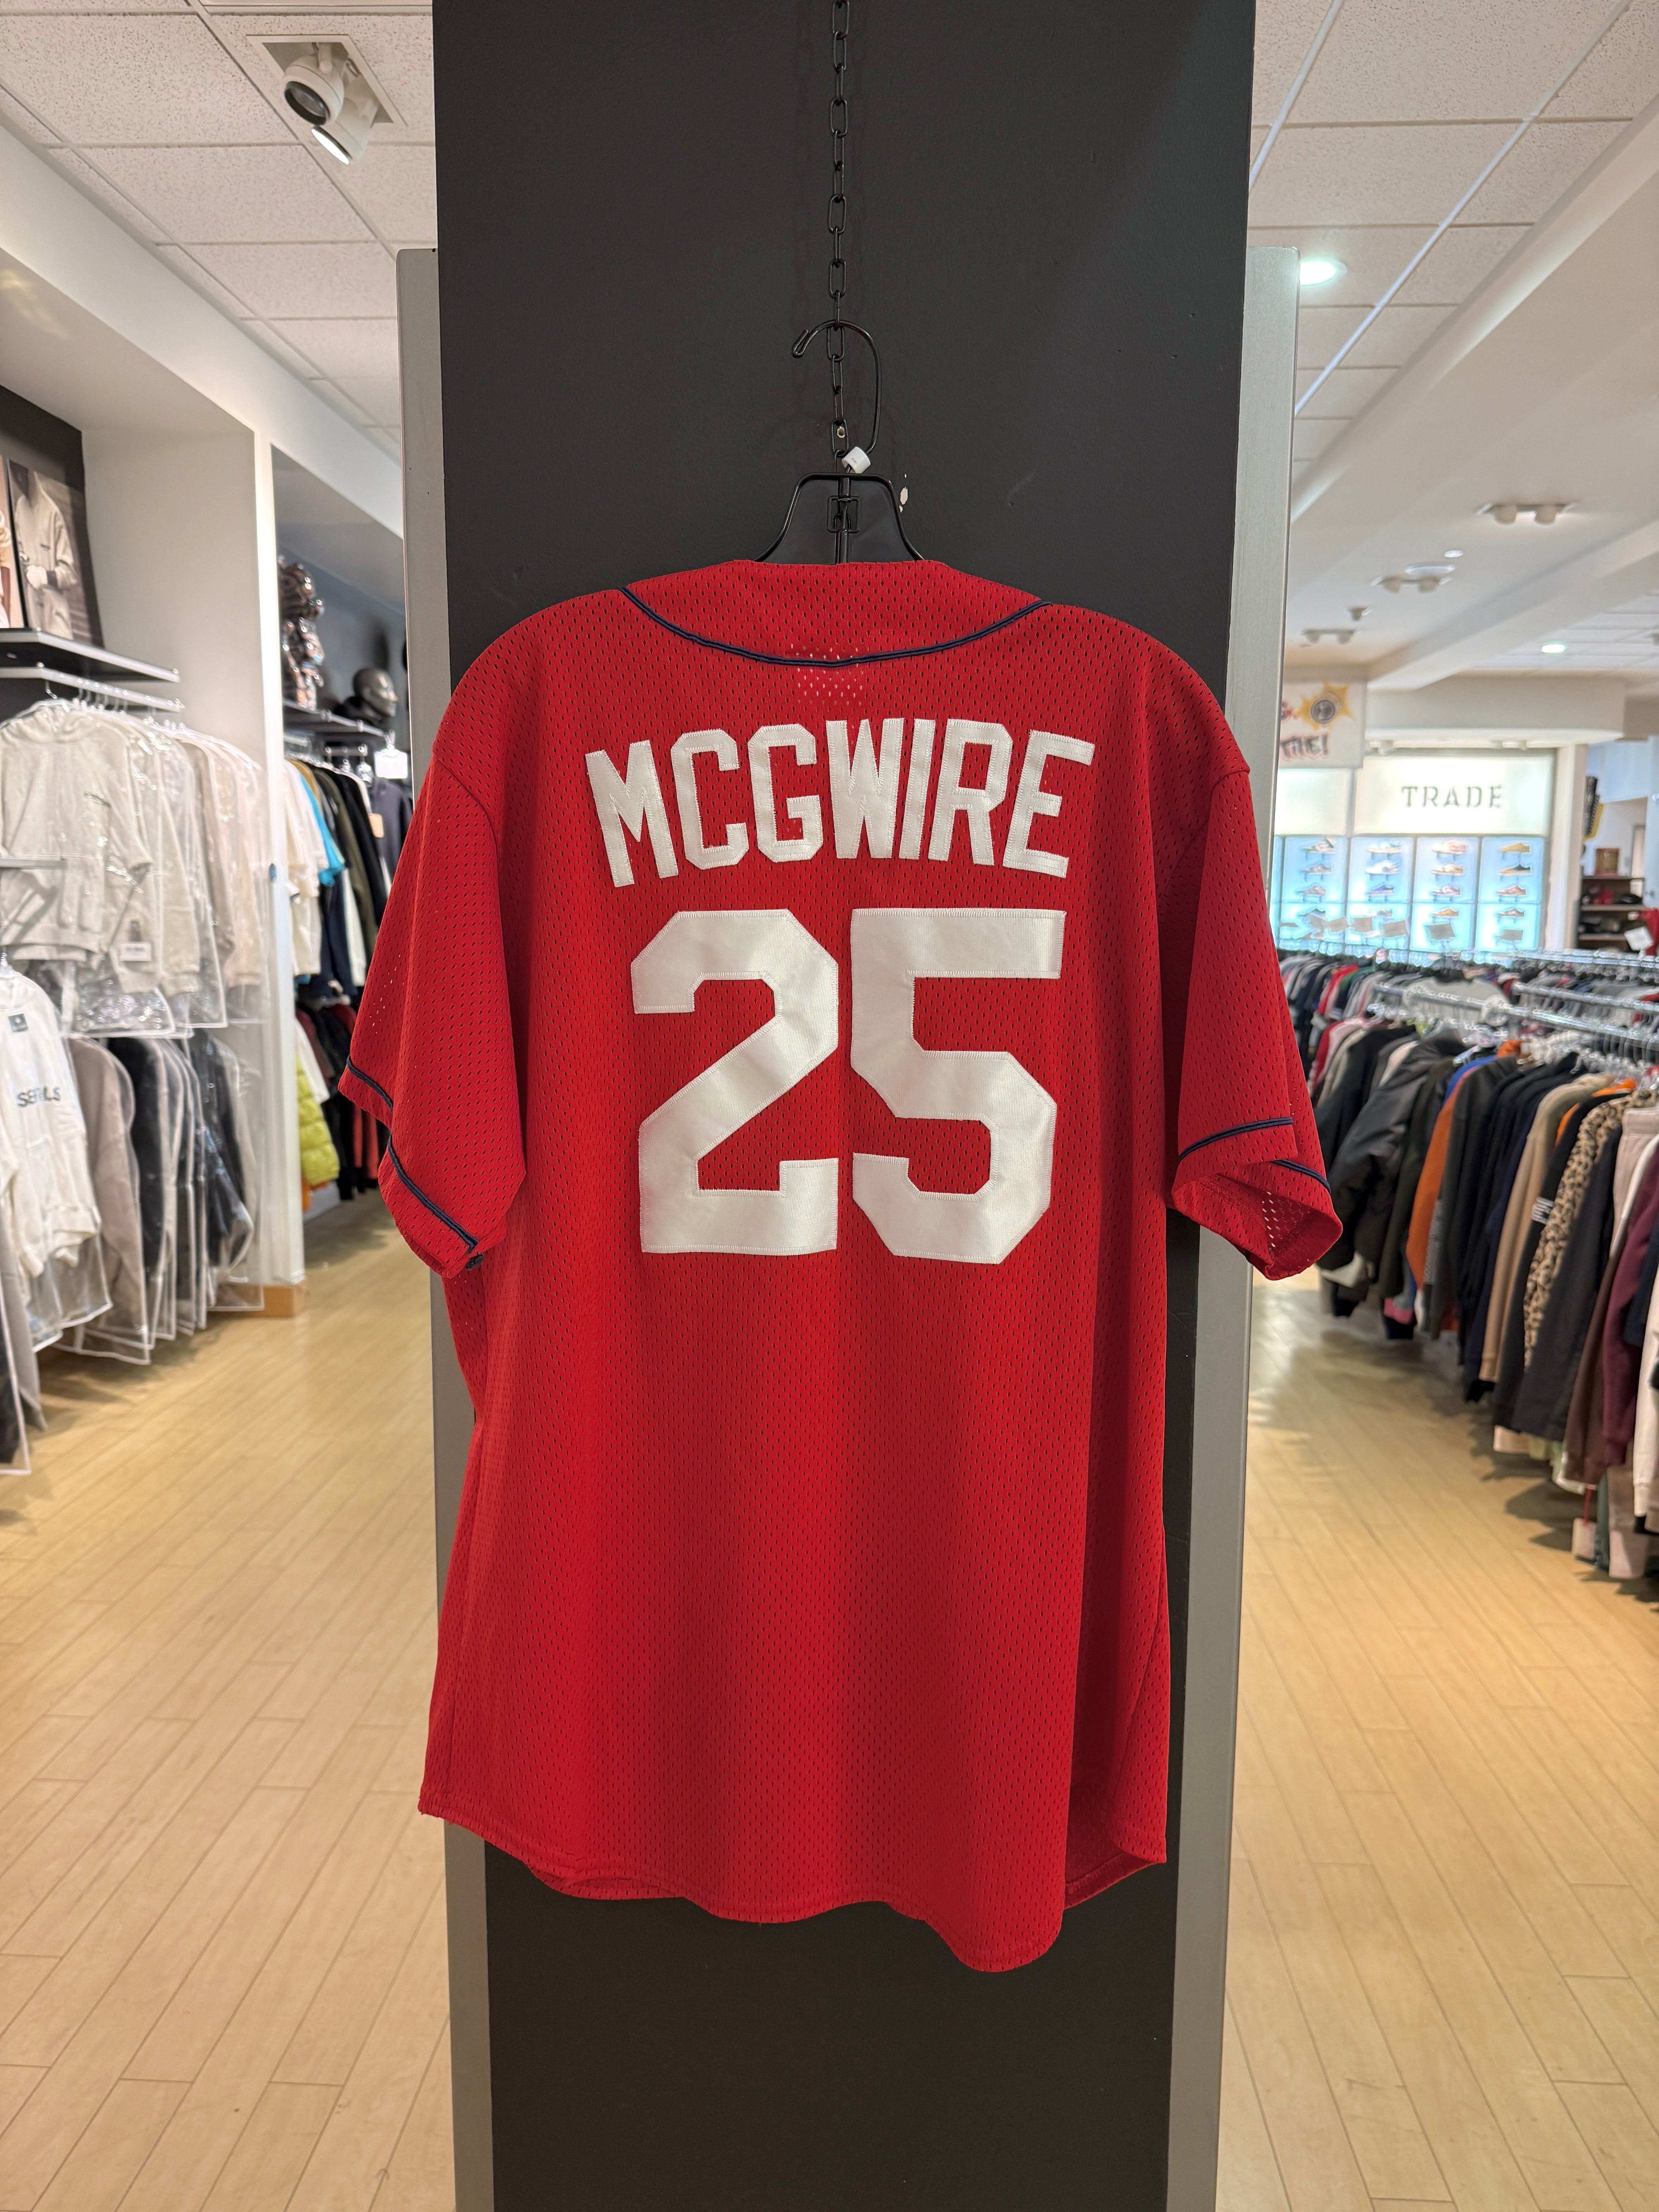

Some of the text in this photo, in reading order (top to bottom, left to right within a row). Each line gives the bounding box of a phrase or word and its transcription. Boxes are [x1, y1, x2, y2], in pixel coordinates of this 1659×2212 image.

[585, 718, 1095, 887] MCGWIRE
[1401, 784, 1503, 808] TRADE
[631, 907, 1067, 1264] 25
